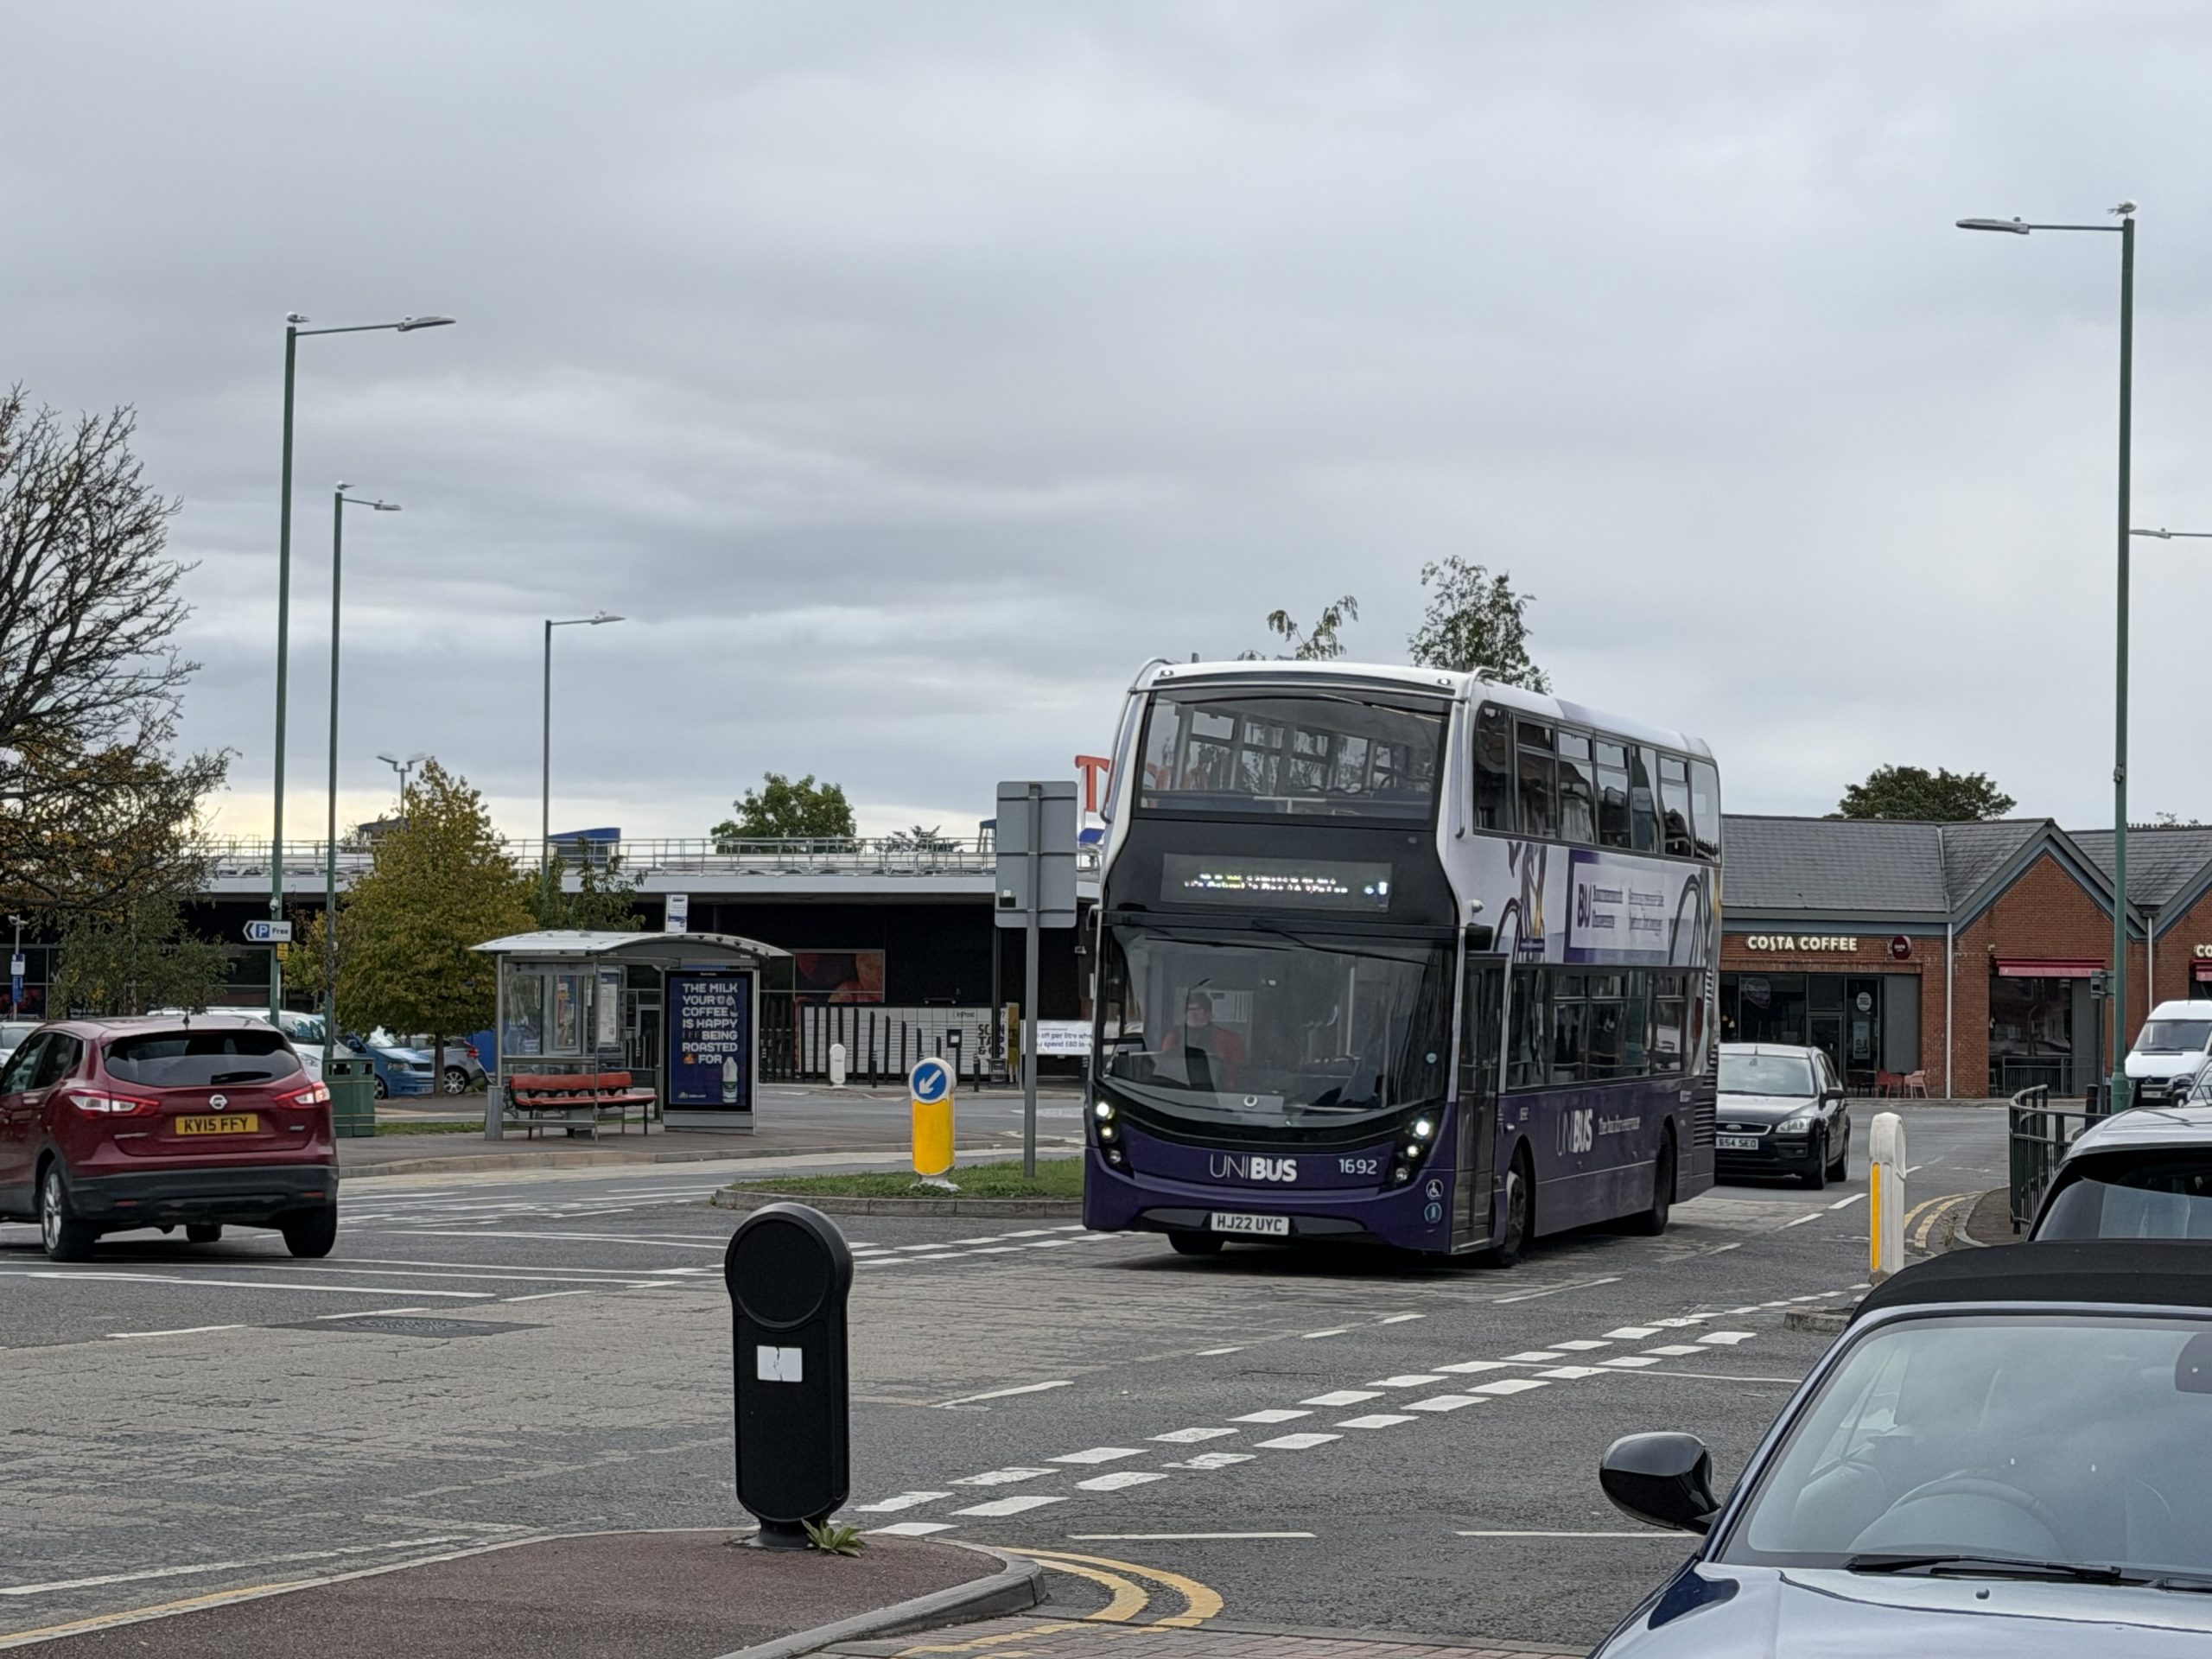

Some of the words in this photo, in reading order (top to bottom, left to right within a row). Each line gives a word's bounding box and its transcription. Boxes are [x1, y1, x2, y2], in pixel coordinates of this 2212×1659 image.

[1577, 883, 1592, 928] BU
[1747, 936, 1795, 951] COSTA
[1800, 937, 1858, 951] COFFEE
[682, 983, 707, 993] THE
[709, 983, 738, 993] MILK
[682, 995, 715, 1005] YOUR
[682, 1007, 728, 1017] COFFEE
[682, 1019, 695, 1028] IS
[696, 1019, 738, 1028] HAPPY
[702, 1031, 738, 1040] BEING
[682, 1042, 738, 1052] ROASTED
[698, 1054, 722, 1065] FOR
[1556, 1109, 1593, 1157] UNIBUS
[1210, 1154, 1298, 1182] UNIBUS
[1339, 1159, 1378, 1175] 1692
[1217, 1215, 1253, 1230] HJ22
[1255, 1217, 1283, 1232] UYC
